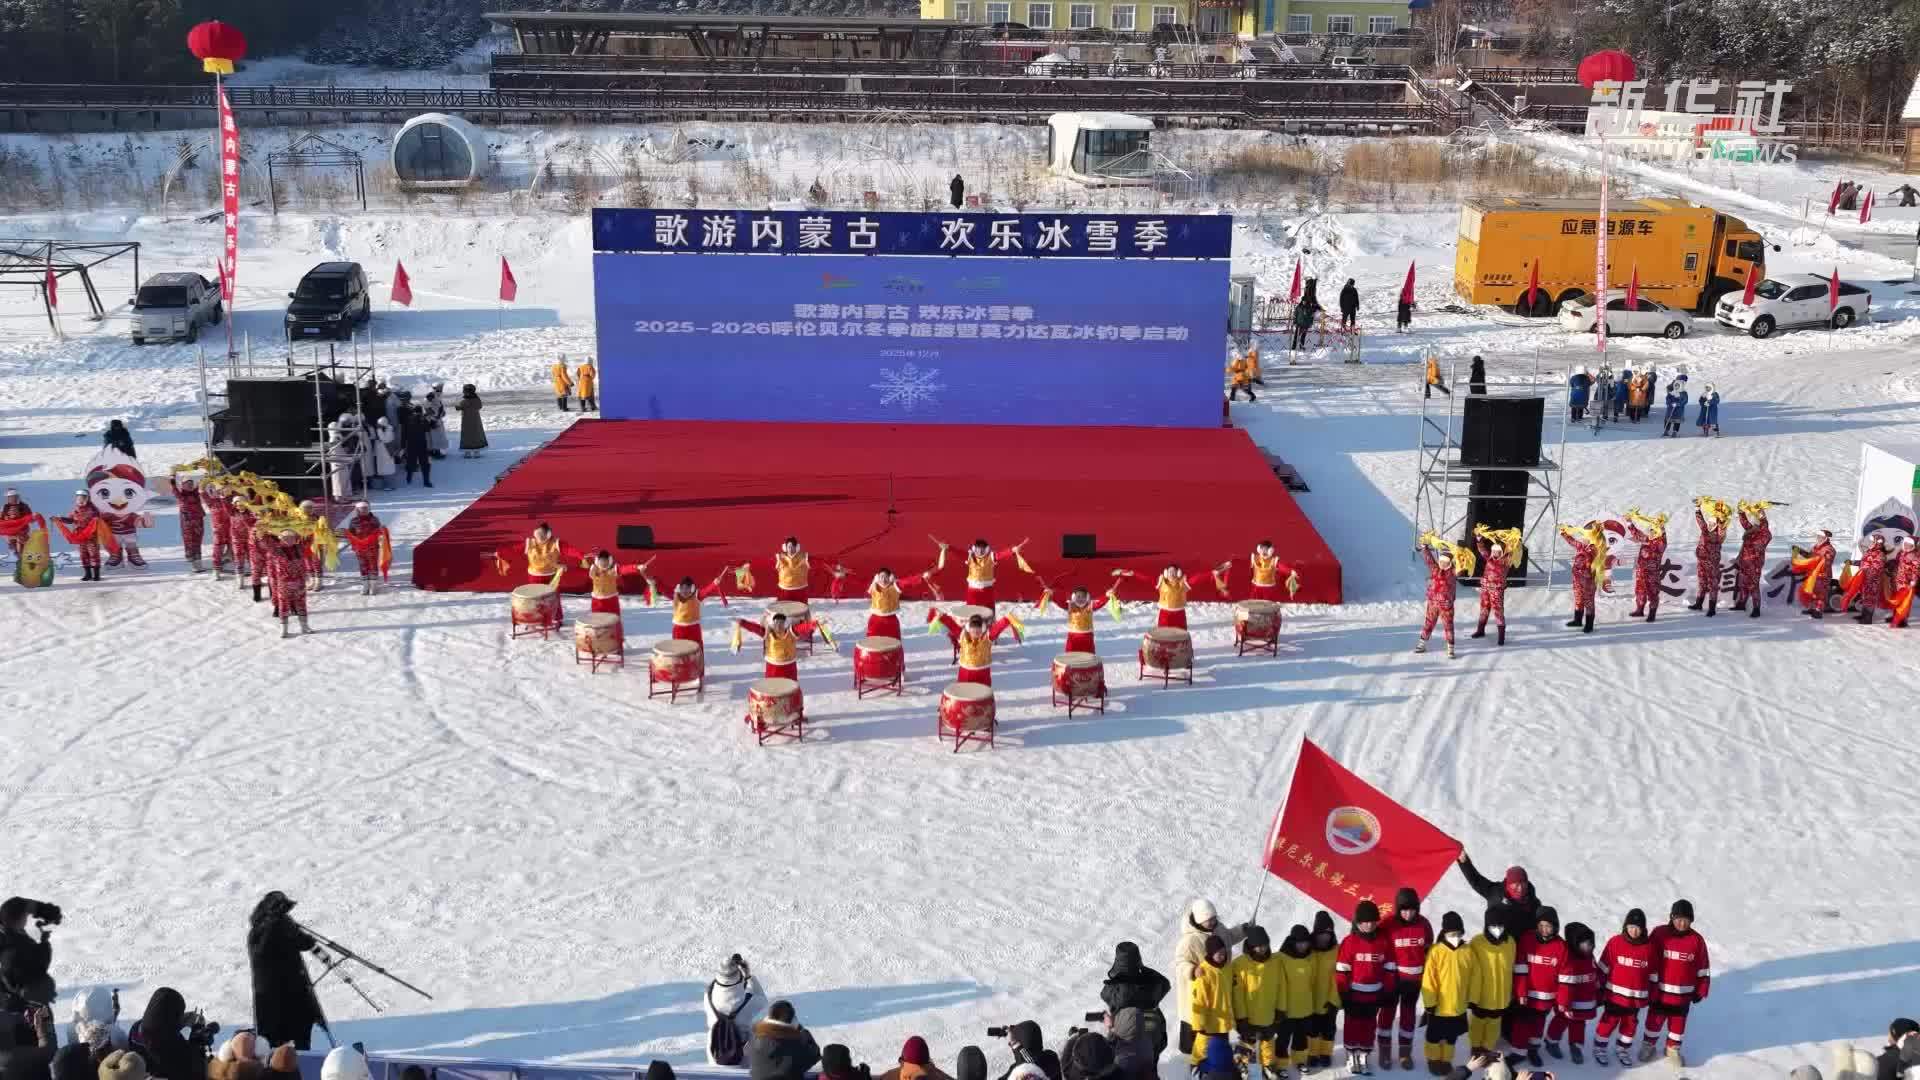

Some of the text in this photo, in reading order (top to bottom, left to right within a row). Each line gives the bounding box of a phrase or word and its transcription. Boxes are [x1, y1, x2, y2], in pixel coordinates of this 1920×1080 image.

[654, 214, 1169, 252] 歌游内蒙古 欢乐冰雪季
[1561, 218, 1656, 236] 应急电源车
[793, 303, 1034, 321] 歌游内蒙古 欢乐冰雪季
